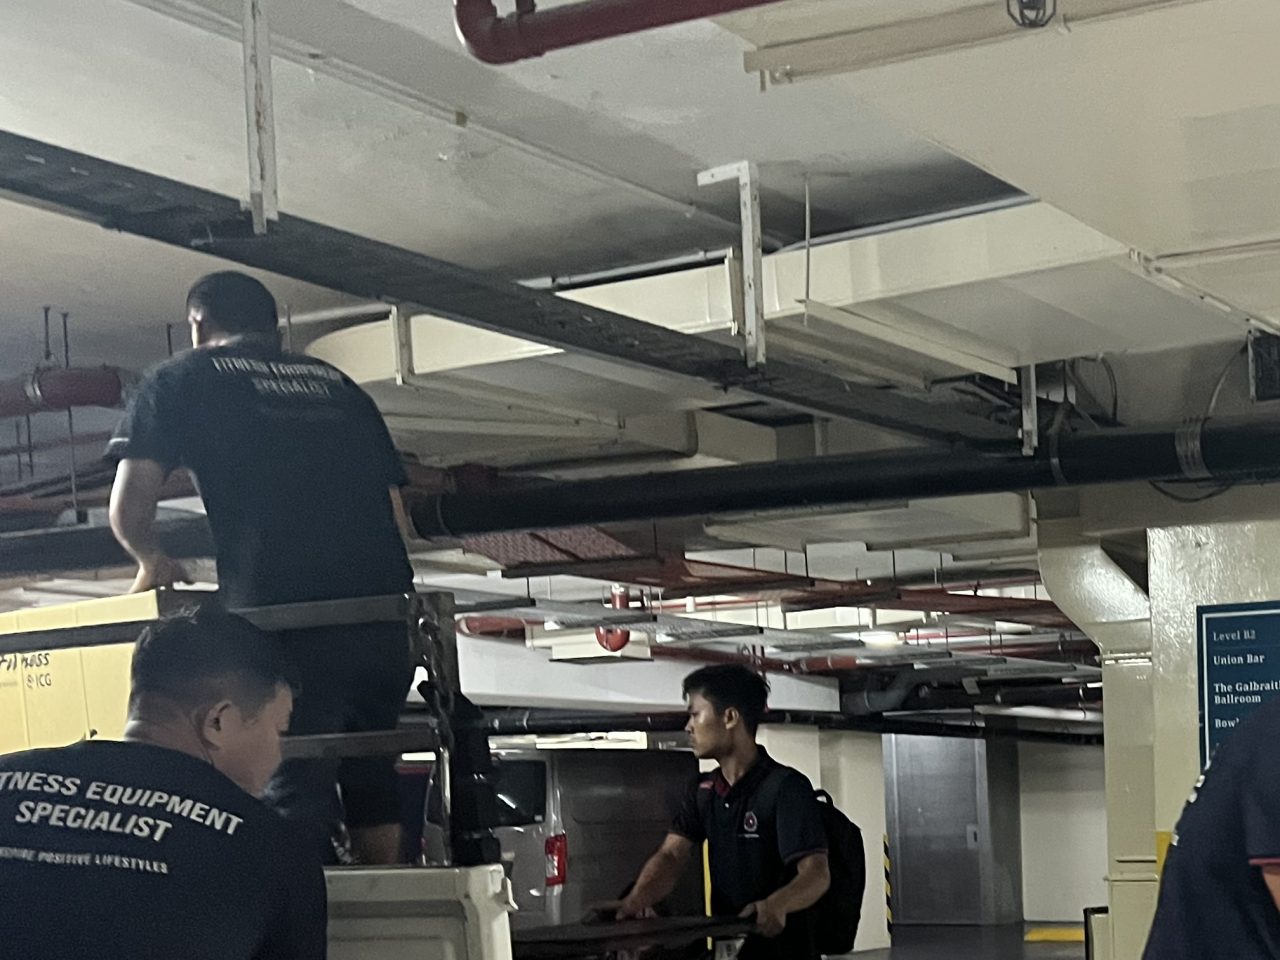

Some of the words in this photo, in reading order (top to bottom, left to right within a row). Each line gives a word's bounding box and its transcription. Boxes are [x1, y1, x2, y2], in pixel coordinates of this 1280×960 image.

[1213, 630, 1241, 642] Level
[1213, 655, 1245, 666] Union
[1246, 653, 1266, 664] Bar
[1213, 682, 1233, 693] The
[1214, 694, 1262, 705] Ballroom
[86, 782, 244, 836] EQUIPMENT
[15, 801, 173, 842] SPECIALIST
[94, 853, 169, 874] LIFESTYLES
